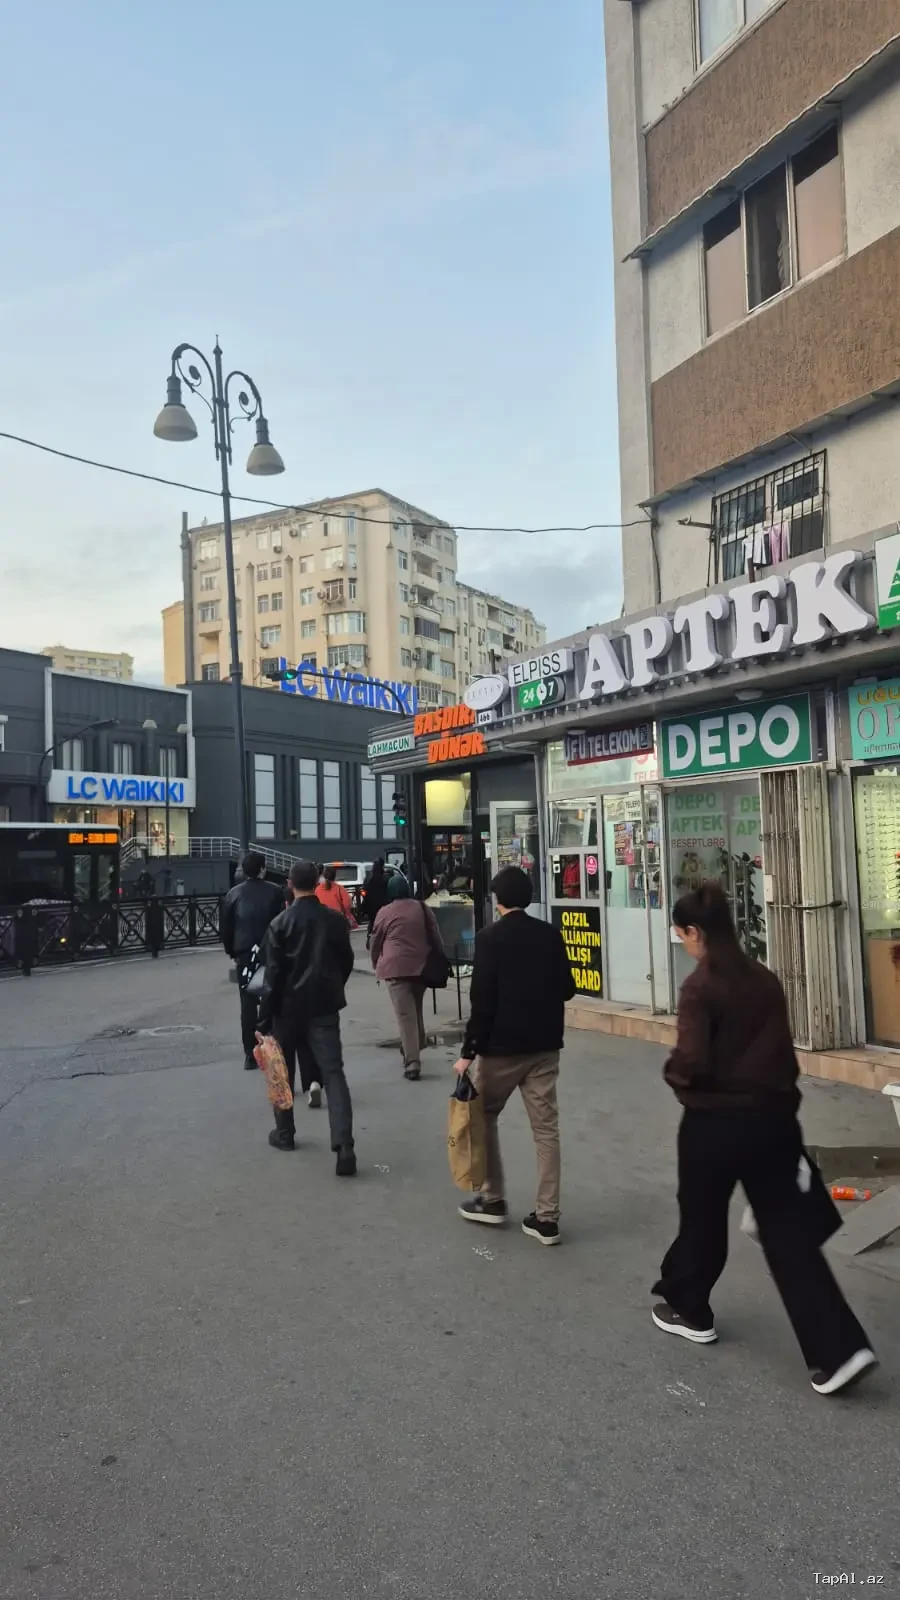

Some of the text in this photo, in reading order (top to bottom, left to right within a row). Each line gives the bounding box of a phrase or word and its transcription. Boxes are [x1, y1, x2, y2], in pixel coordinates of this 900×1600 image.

[580, 551, 874, 699] APTEK
[279, 656, 318, 697] LC
[512, 653, 561, 684] ELPISS
[523, 682, 554, 703] 24 7
[368, 737, 410, 756] LAHMACUN
[588, 727, 640, 758] TELEKOM
[667, 704, 800, 771] DEPO
[67, 776, 98, 799] LC
[674, 793, 717, 811] DEPO
[671, 815, 723, 833] APTEK
[736, 819, 760, 836] AP
[562, 911, 590, 928] QIZIL
